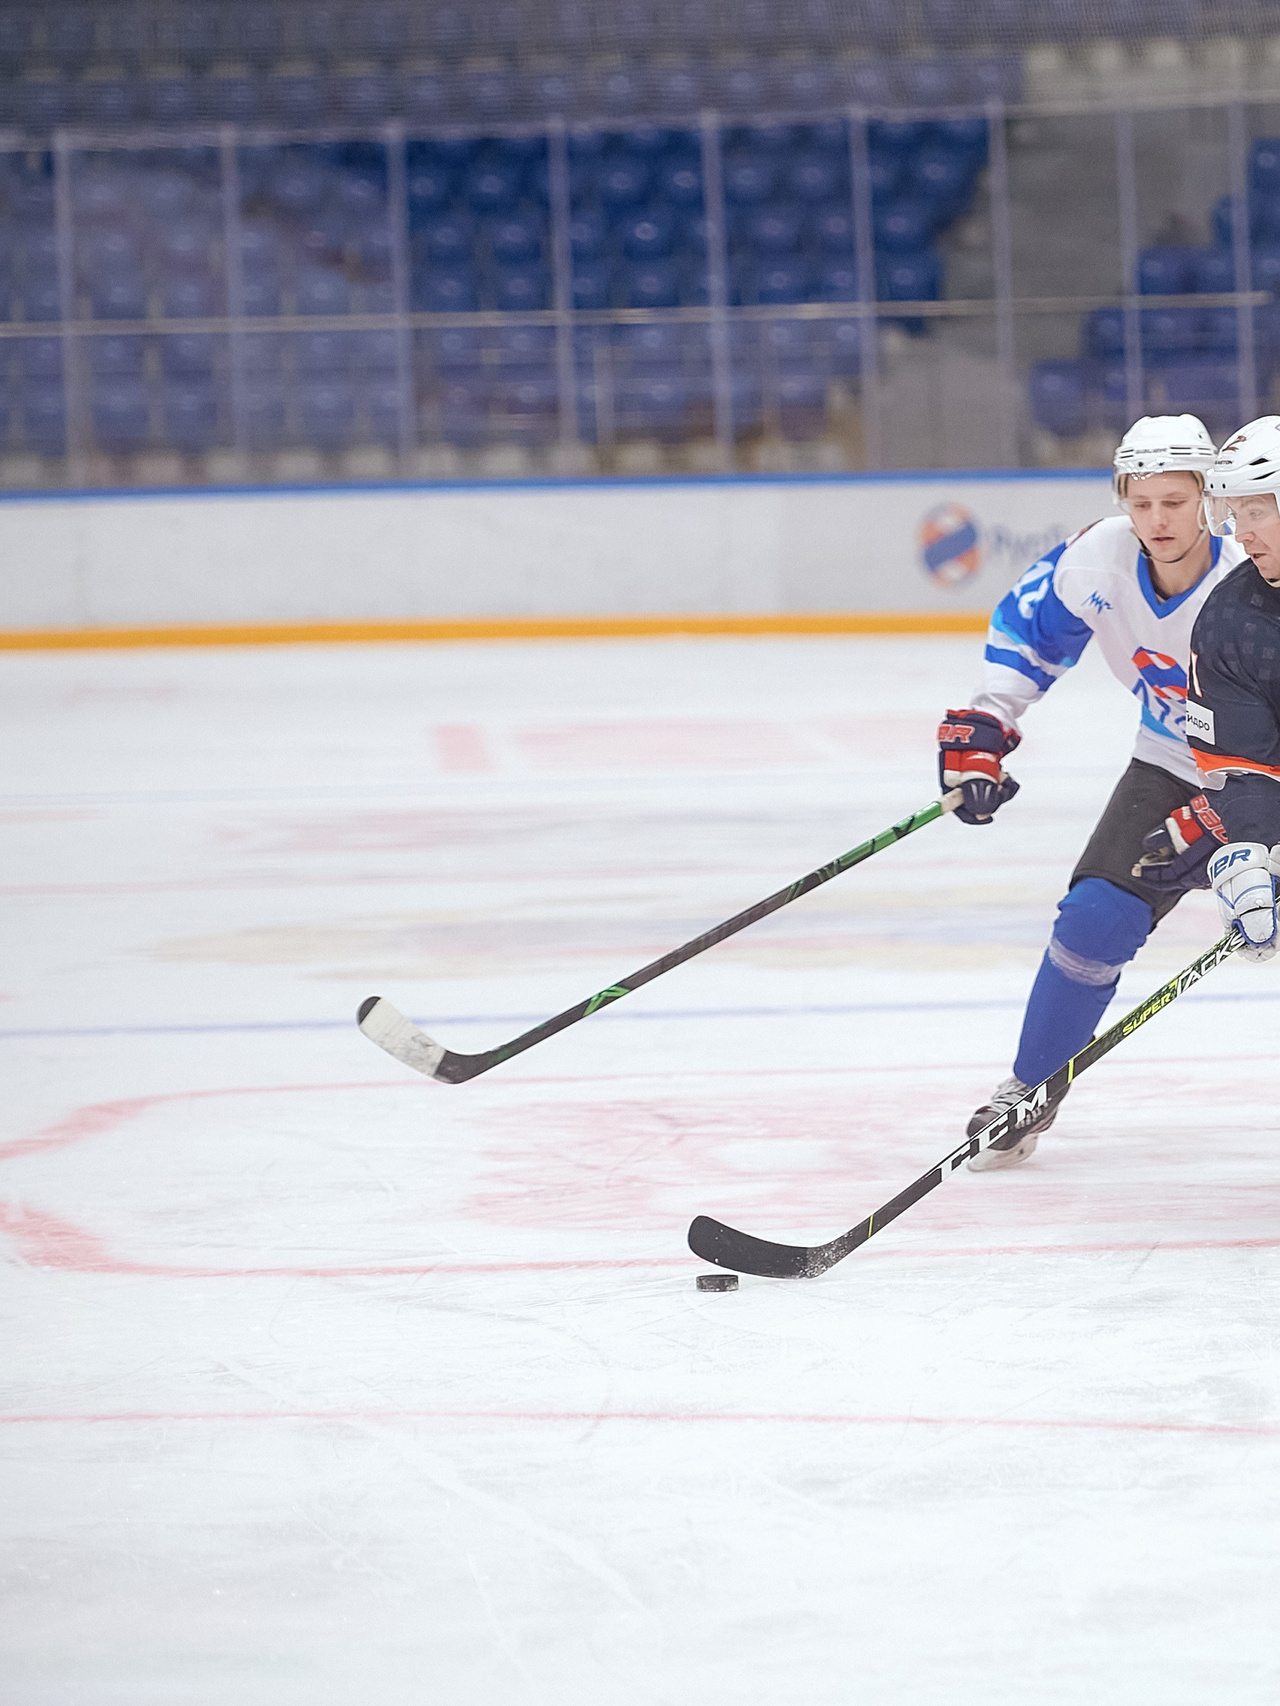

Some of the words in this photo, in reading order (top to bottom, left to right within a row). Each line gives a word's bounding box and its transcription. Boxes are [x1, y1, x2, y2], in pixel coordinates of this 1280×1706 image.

[1186, 709, 1211, 732] идро
[1122, 992, 1172, 1036] SUPER
[1168, 932, 1246, 997] TACKS
[940, 1082, 1048, 1182] CCM
